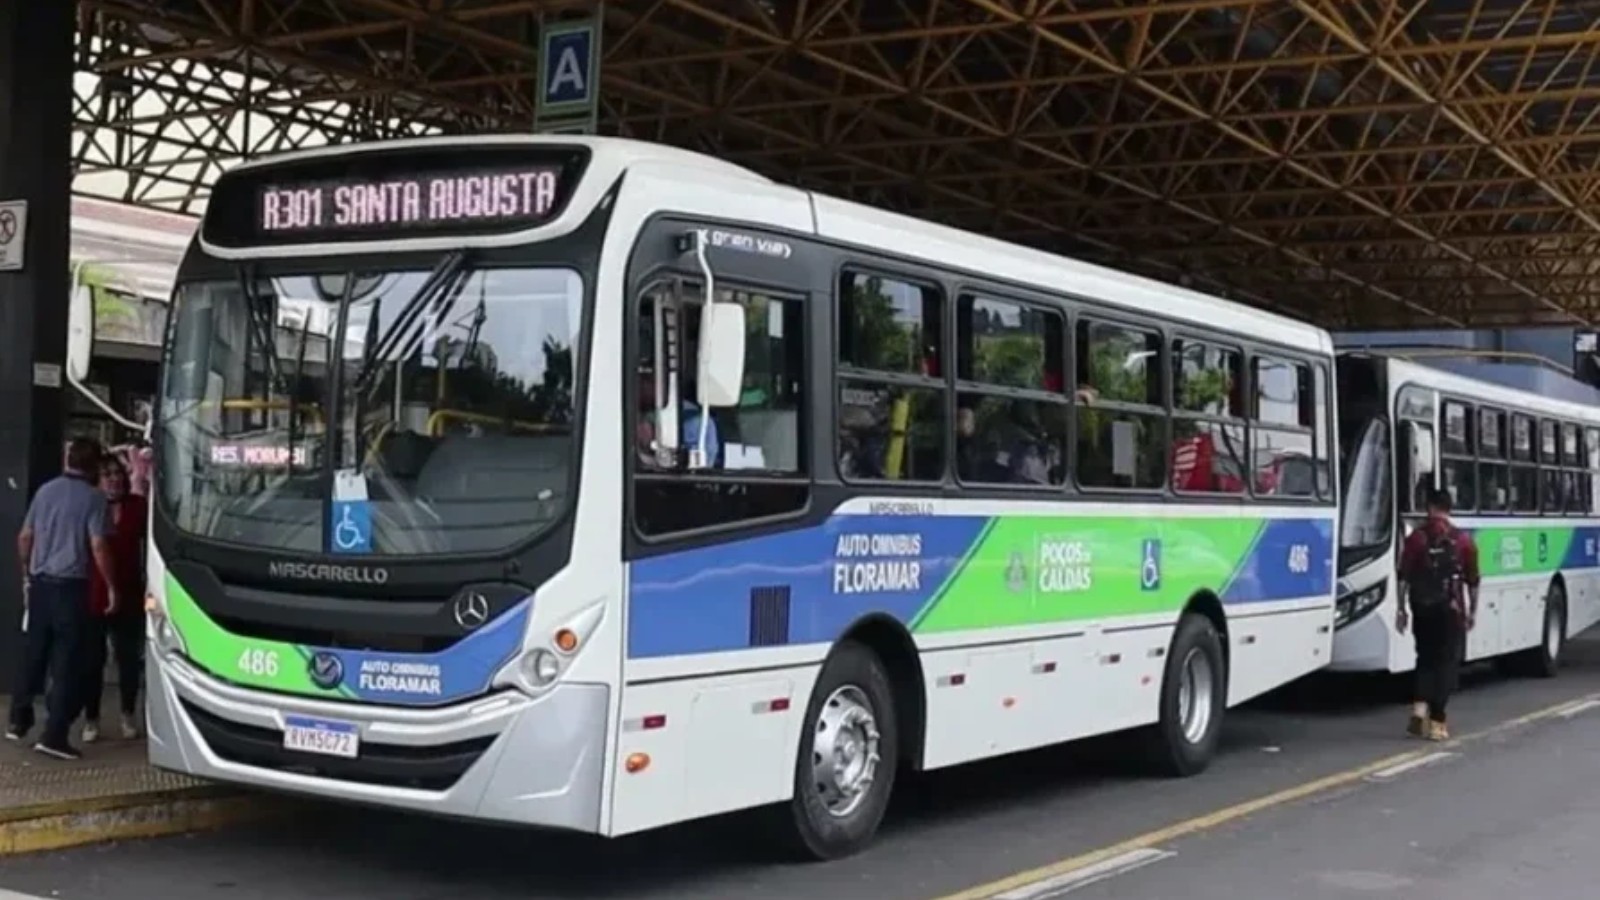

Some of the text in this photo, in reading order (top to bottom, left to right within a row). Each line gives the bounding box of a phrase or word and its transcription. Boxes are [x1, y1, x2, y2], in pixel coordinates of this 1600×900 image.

[549, 46, 584, 94] A
[263, 171, 556, 230] R301 SANTA AUGUSTA
[836, 533, 870, 557] AUTO
[1288, 544, 1309, 573] 486
[269, 561, 388, 584] MASCARELLO
[833, 561, 921, 594] FLORAMAR
[1039, 566, 1092, 593] CALDAS
[238, 648, 279, 677] 486
[360, 659, 390, 672] AUTO
[359, 673, 442, 695] FLORAMAR
